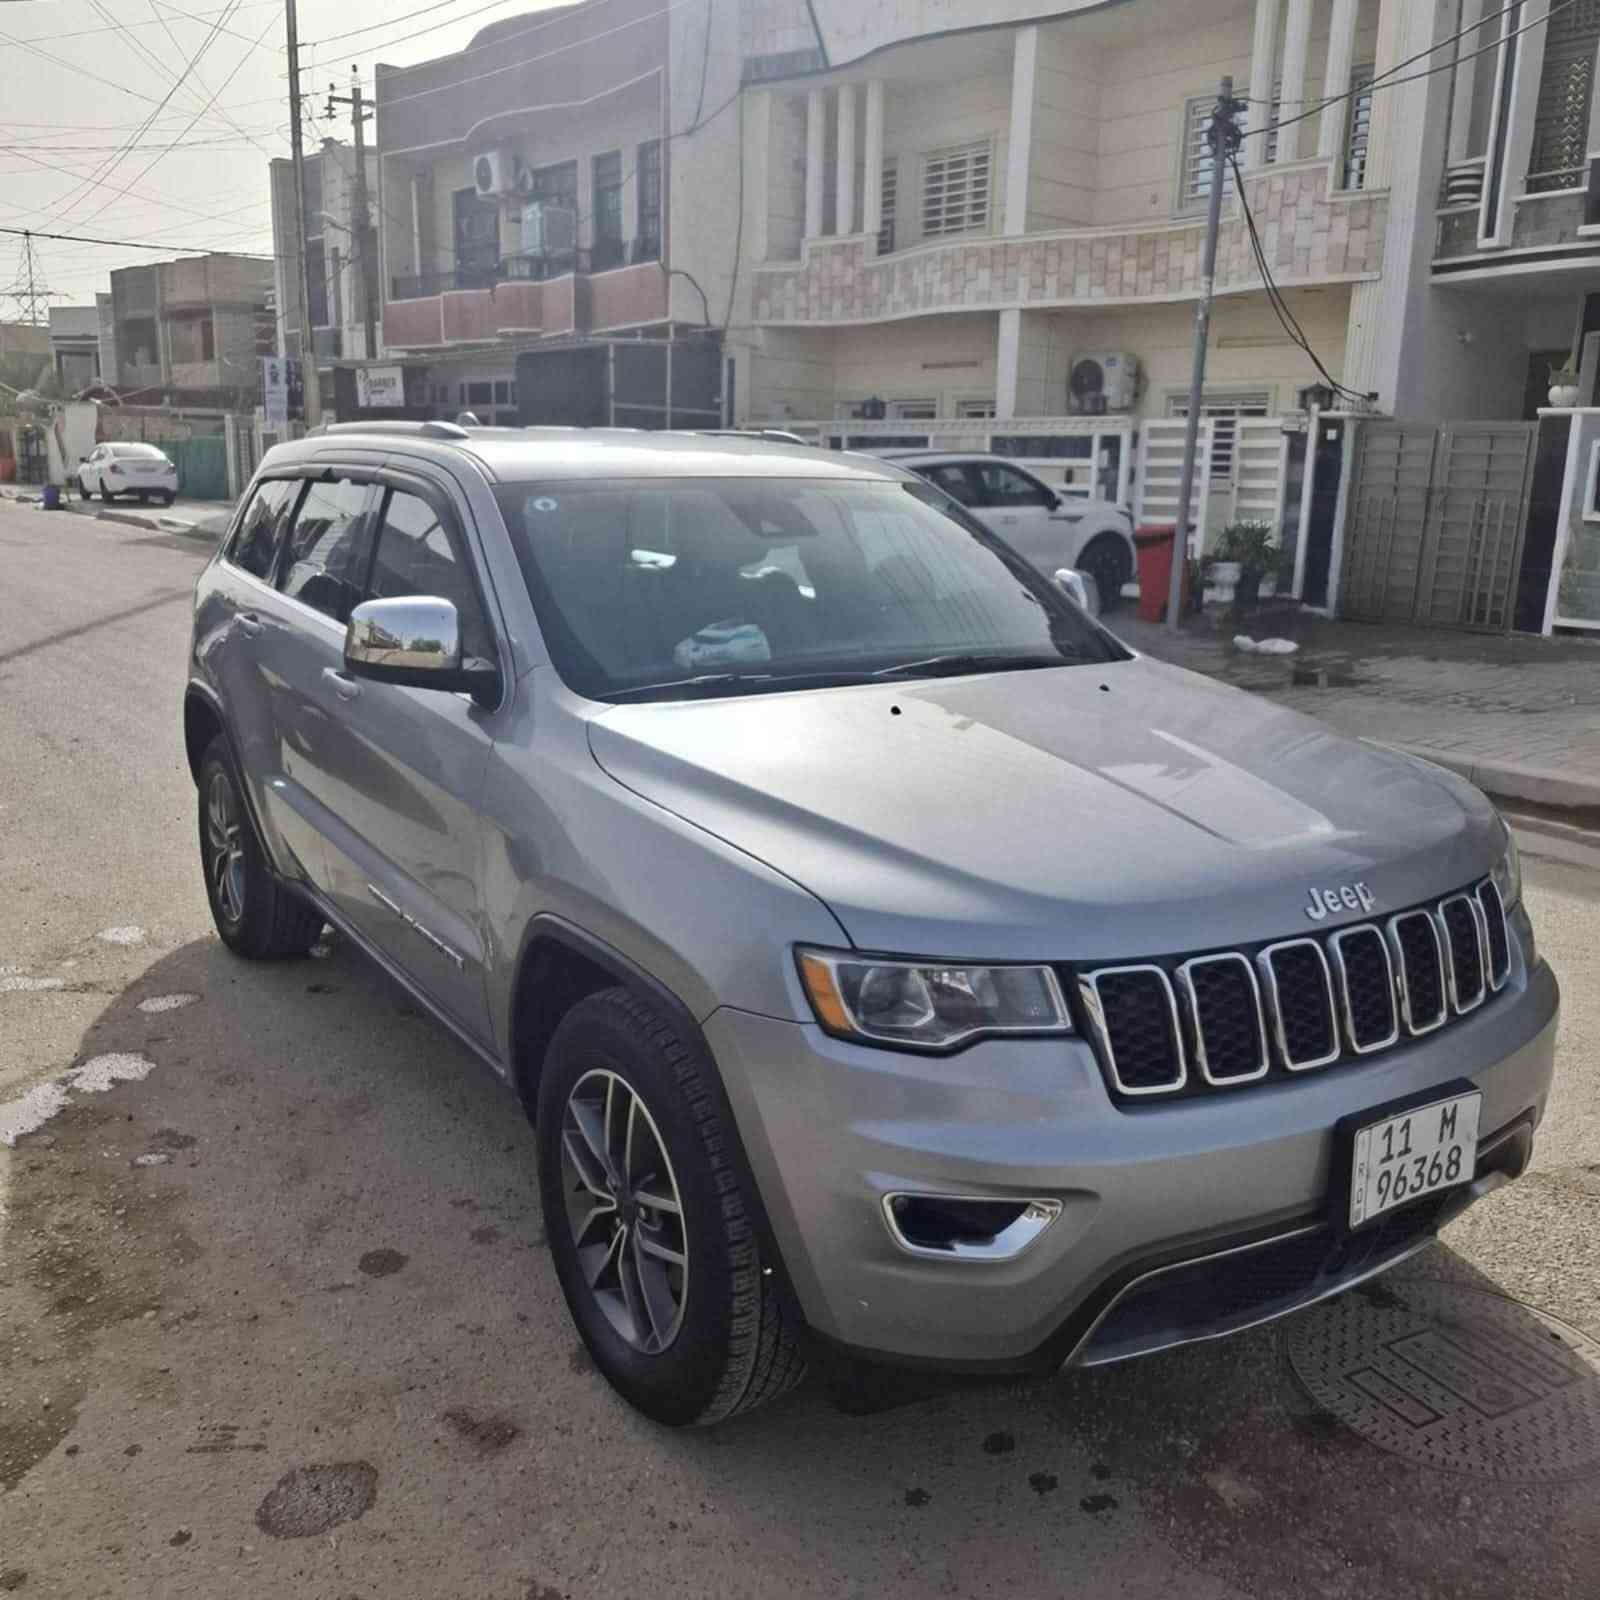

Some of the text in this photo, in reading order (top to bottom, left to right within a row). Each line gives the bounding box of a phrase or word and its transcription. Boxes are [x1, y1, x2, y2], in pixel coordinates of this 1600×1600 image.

[1305, 882, 1376, 920] Jeep
[1379, 1103, 1458, 1165] 11 M
[1377, 1145, 1462, 1208] 96368
